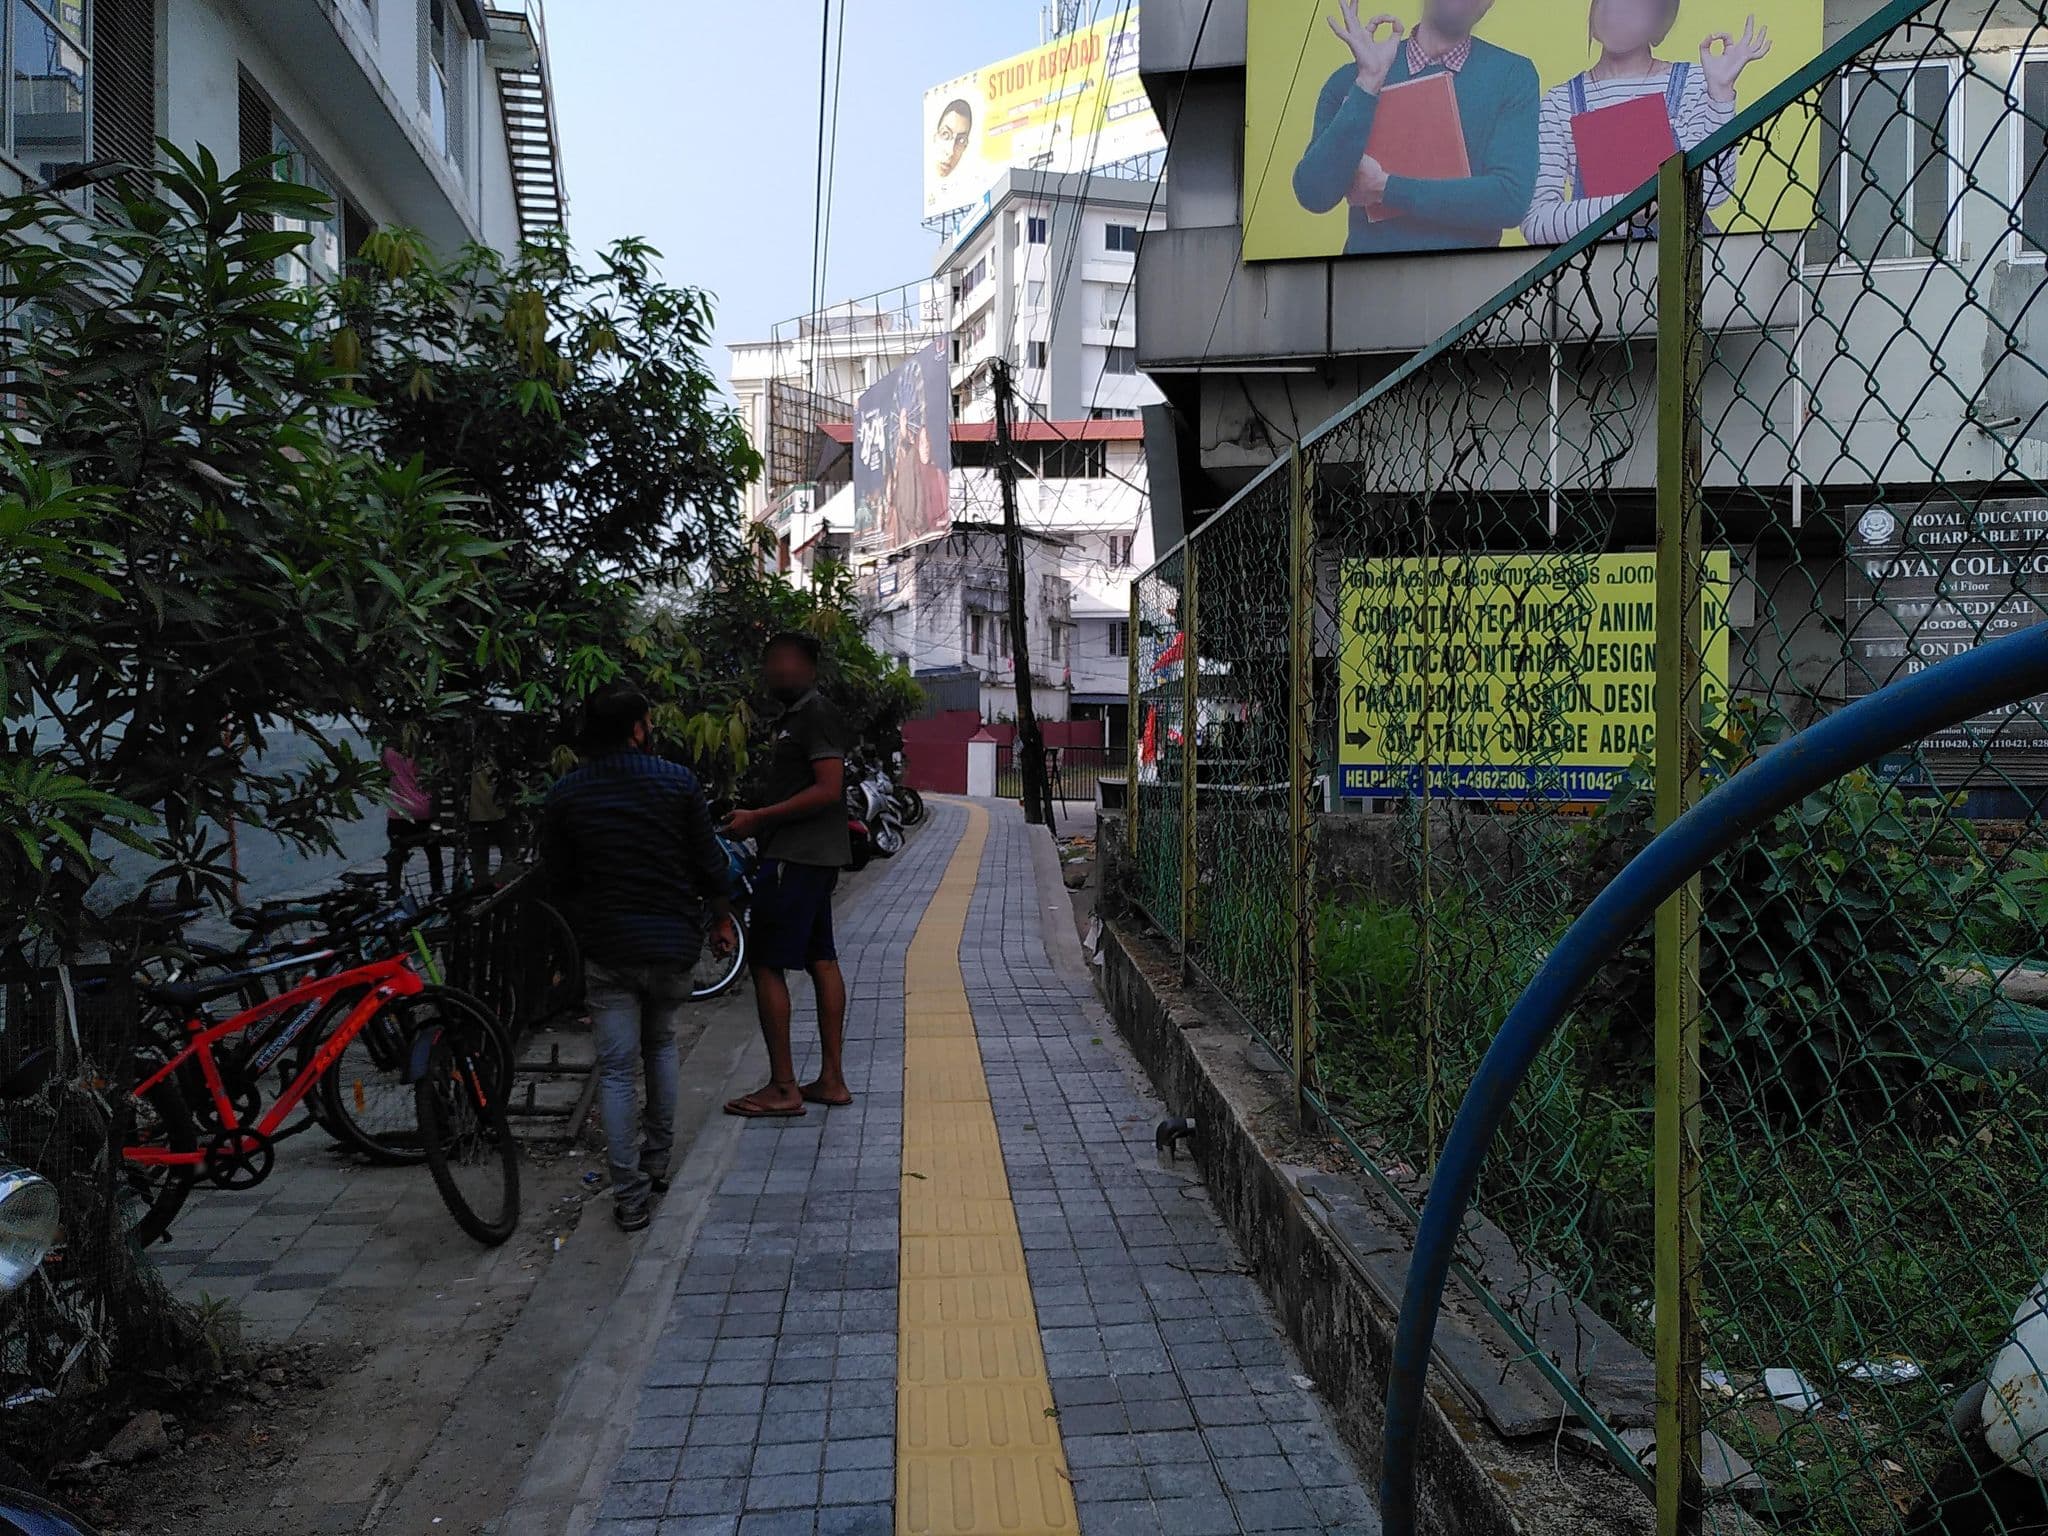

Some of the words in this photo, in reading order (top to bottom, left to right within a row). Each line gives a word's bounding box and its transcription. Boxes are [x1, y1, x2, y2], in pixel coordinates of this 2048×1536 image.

[988, 60, 1034, 100] STUDY
[1038, 34, 1101, 81] ABROAD
[1913, 513, 1965, 527] ROYAL
[1865, 559, 1941, 579] ROYAL
[1960, 581, 1991, 592] Floor
[1355, 604, 1465, 634] COMPUTER
[1475, 603, 1589, 634] TECHNICAL
[1599, 602, 1716, 632] ANIMN
[1375, 644, 1466, 674] AUTOCAD
[1477, 643, 1571, 674] INTERIOR
[1355, 684, 1495, 714] PARAMEDICAL
[1505, 683, 1592, 714] FASHION
[1433, 724, 1489, 753] TALLY
[1501, 723, 1588, 753] COLLEGE
[1599, 724, 1657, 753] ABAC
[1345, 769, 1410, 789] HELPLINE
